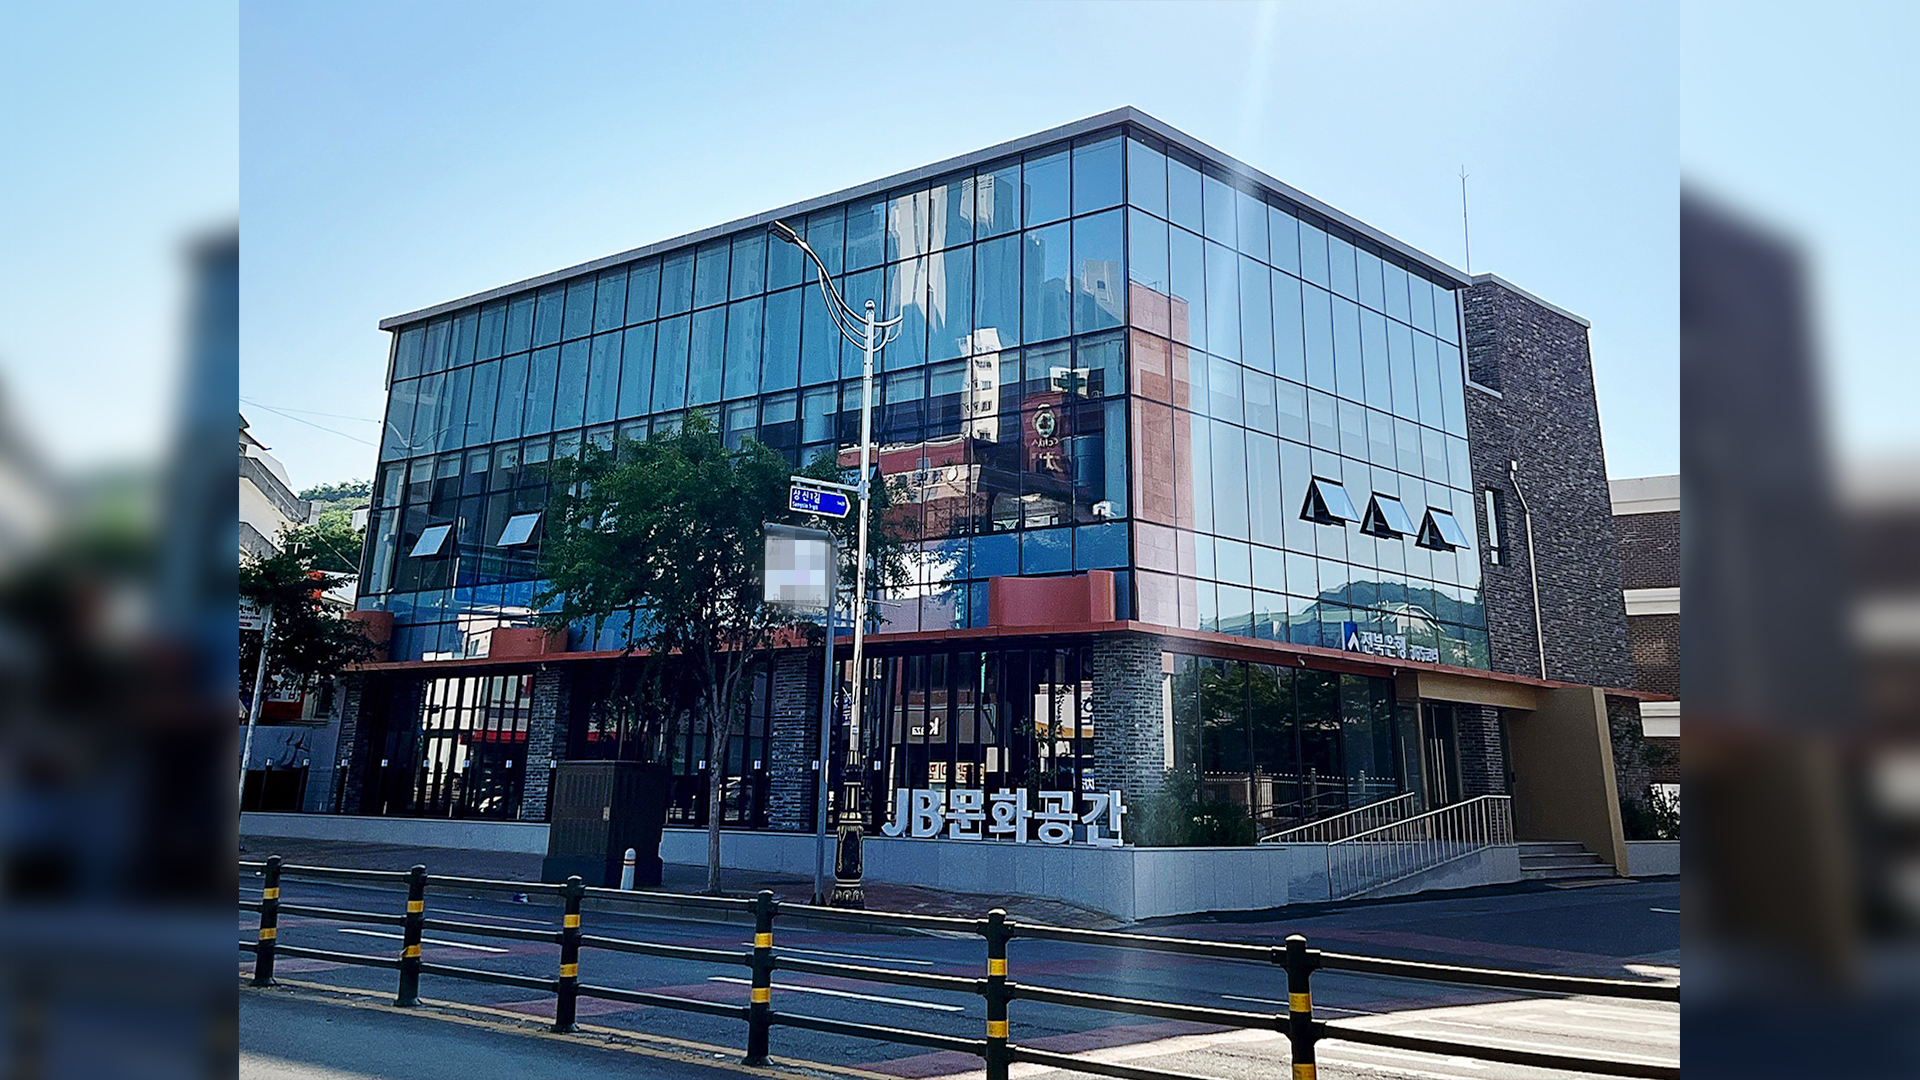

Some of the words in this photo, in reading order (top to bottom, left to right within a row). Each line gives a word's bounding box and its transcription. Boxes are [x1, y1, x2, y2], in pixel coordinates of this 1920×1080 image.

[793, 489, 820, 504] 상신1길
[1361, 631, 1406, 659] 전북은행
[881, 788, 1127, 847] JB문화공간
